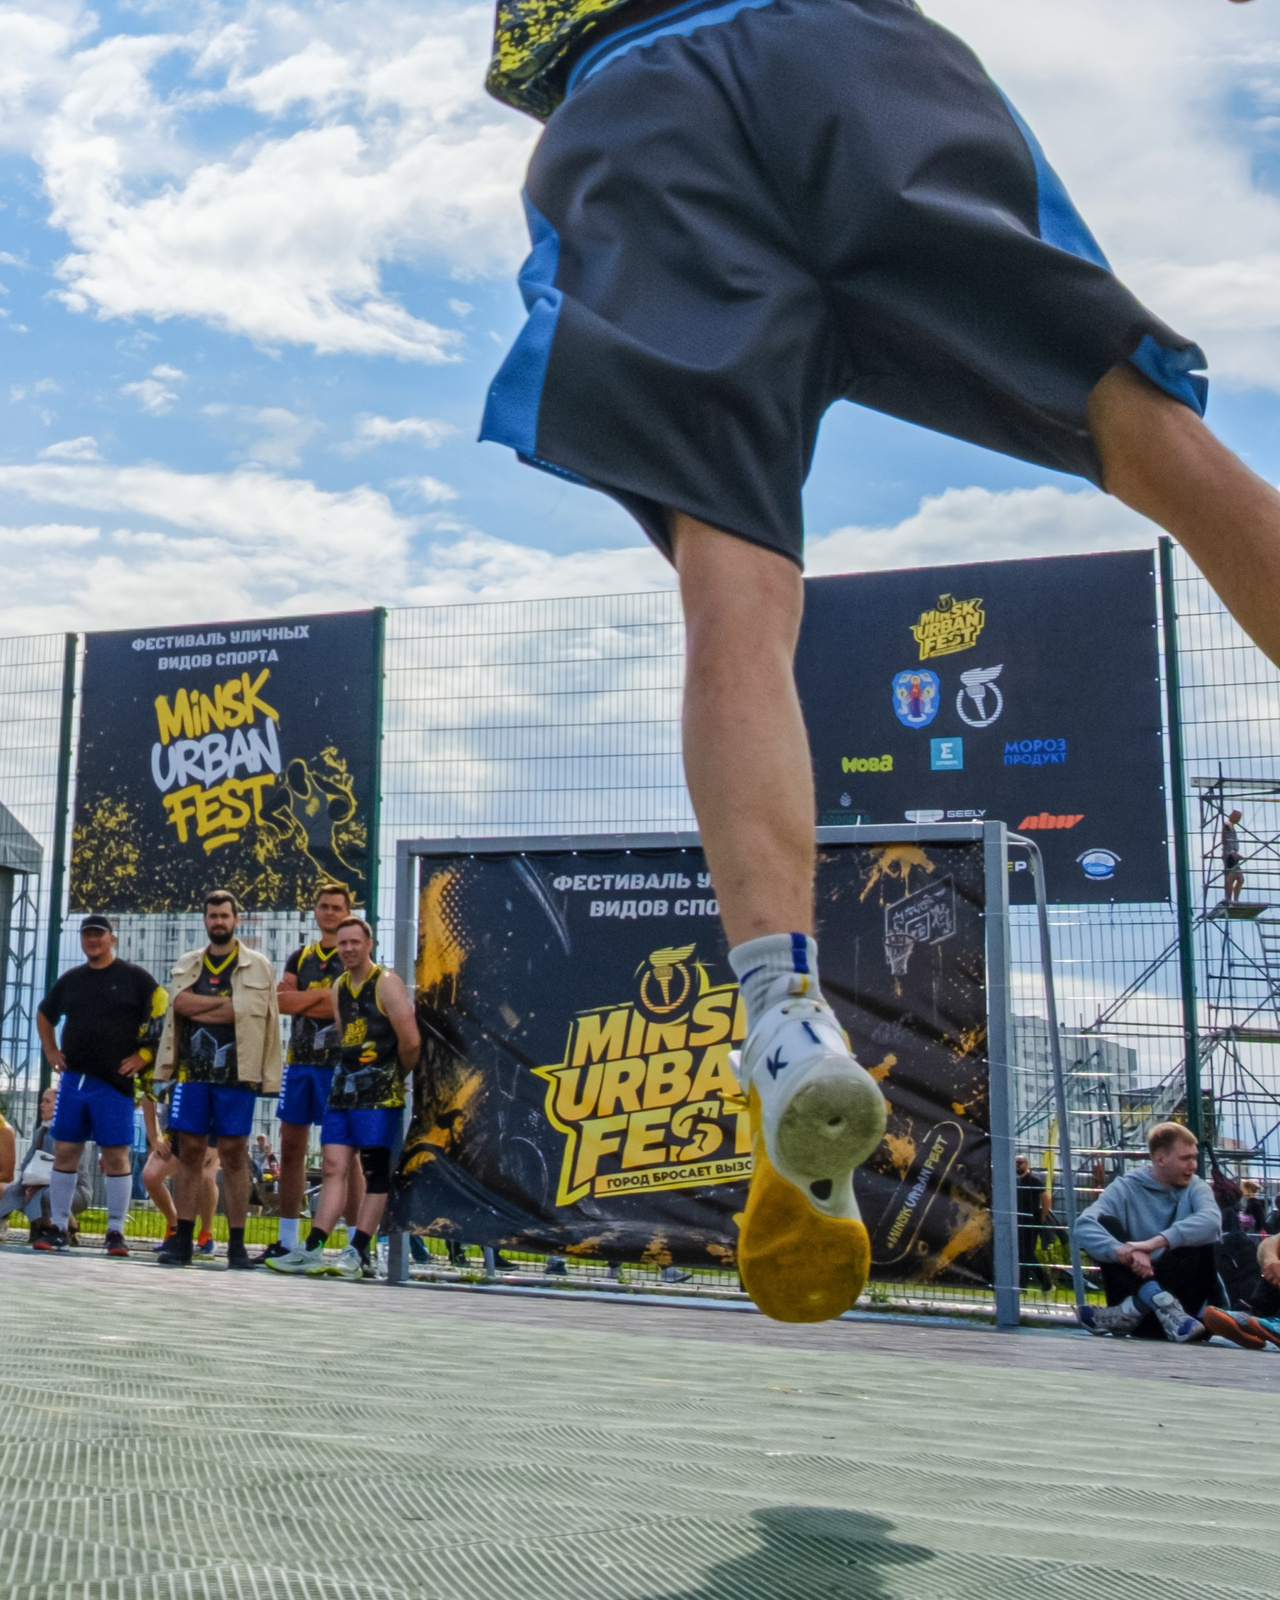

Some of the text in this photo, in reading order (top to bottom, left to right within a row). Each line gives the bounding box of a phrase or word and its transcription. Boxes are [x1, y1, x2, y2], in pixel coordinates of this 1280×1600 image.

[920, 601, 976, 626] MINSK
[917, 612, 980, 640] URBAN
[131, 625, 310, 651] ФЕСТИВАЛЬ УЛИЧНЫХ
[923, 627, 975, 655] FEST
[158, 649, 280, 671] ВИДОВ СПОРТА
[150, 716, 282, 793] URBAN
[1004, 738, 1067, 754] МОРОЗ
[1003, 752, 1067, 766] ПРОДУКТ
[162, 773, 276, 843] FEST
[946, 808, 987, 818] GEELY
[552, 872, 691, 891] ФЕСТИВАЛЬ
[589, 900, 668, 919] ВИДОВ
[607, 1174, 650, 1189] ГОРОД
[653, 1166, 712, 1183] БРОСАЕТ
